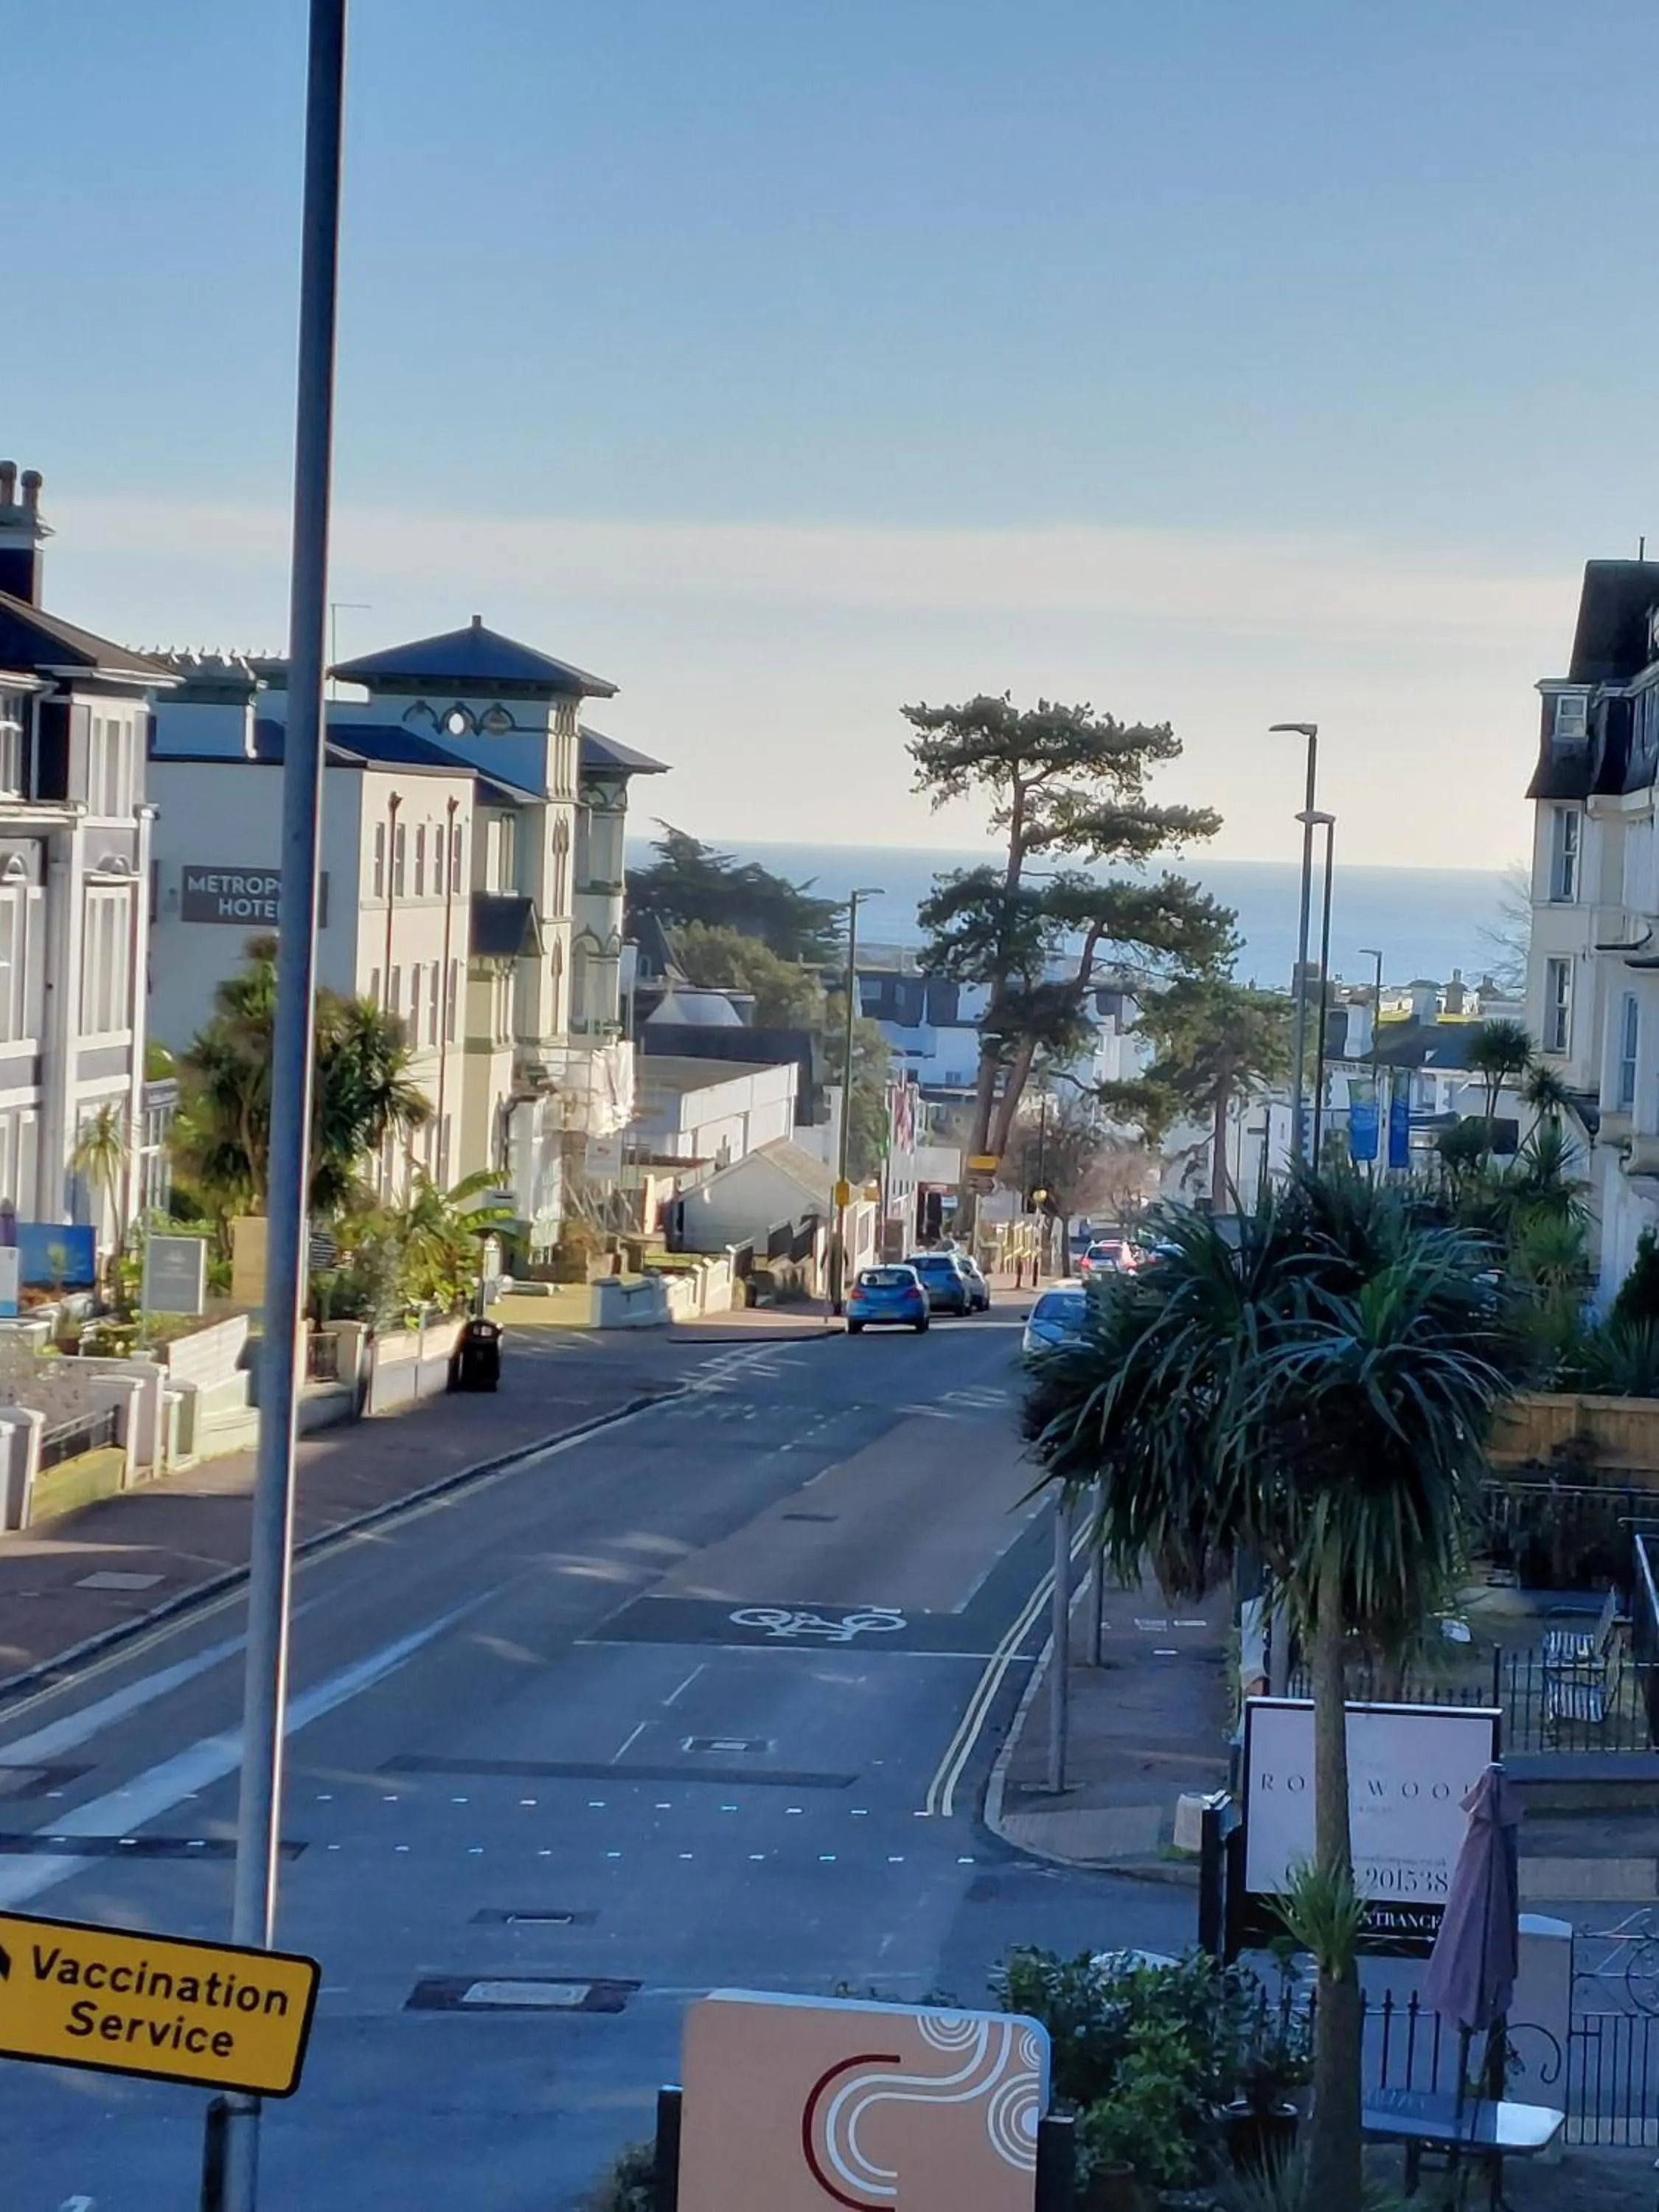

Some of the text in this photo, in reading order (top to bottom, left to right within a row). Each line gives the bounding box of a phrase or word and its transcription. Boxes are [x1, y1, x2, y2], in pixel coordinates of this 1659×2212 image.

[187, 874, 282, 894] METROP
[32, 1944, 288, 2016] Vaccination
[66, 2000, 234, 2057] Service
